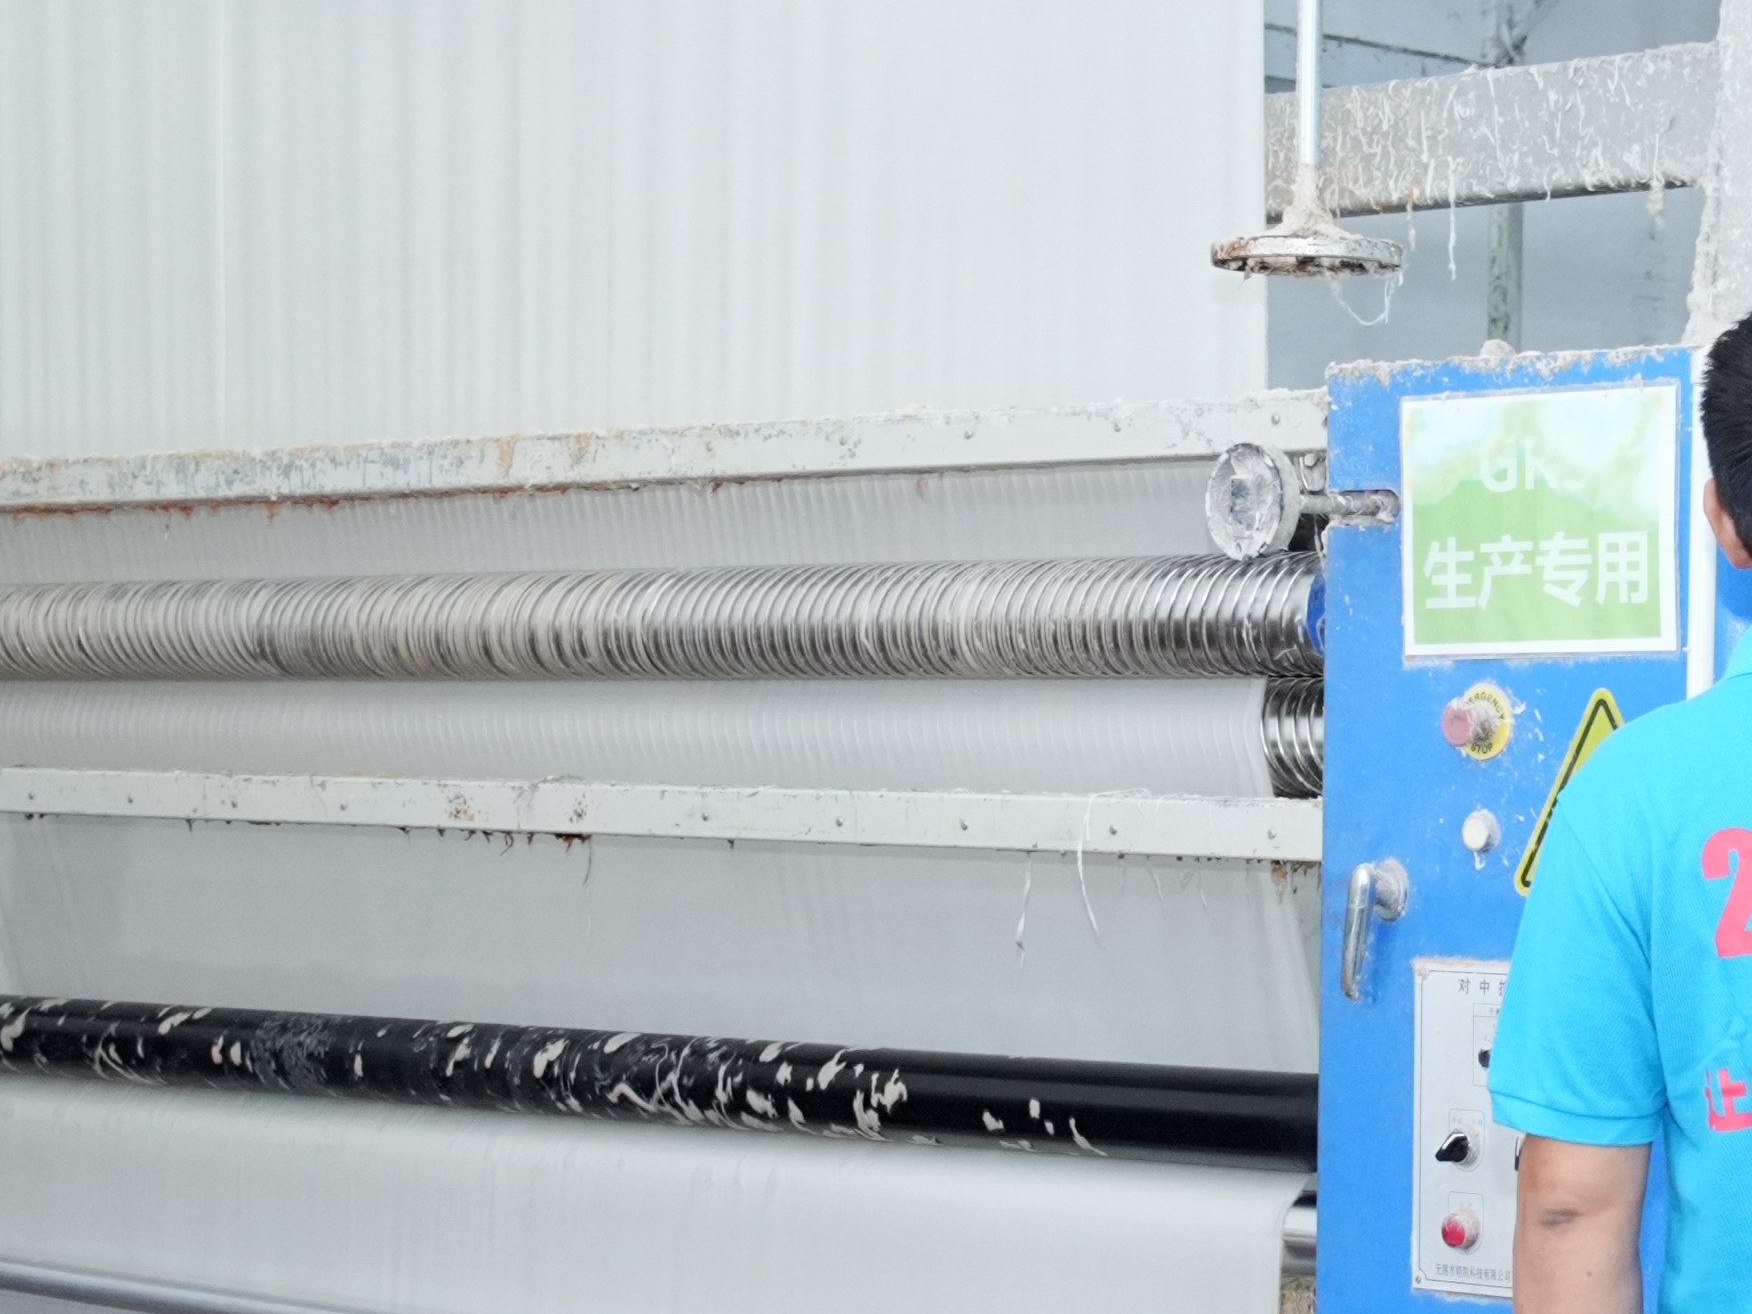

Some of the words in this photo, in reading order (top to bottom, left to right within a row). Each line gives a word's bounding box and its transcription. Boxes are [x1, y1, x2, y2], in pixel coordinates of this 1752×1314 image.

[1423, 531, 1649, 610] 生产专用
[1470, 741, 1493, 755] STOP
